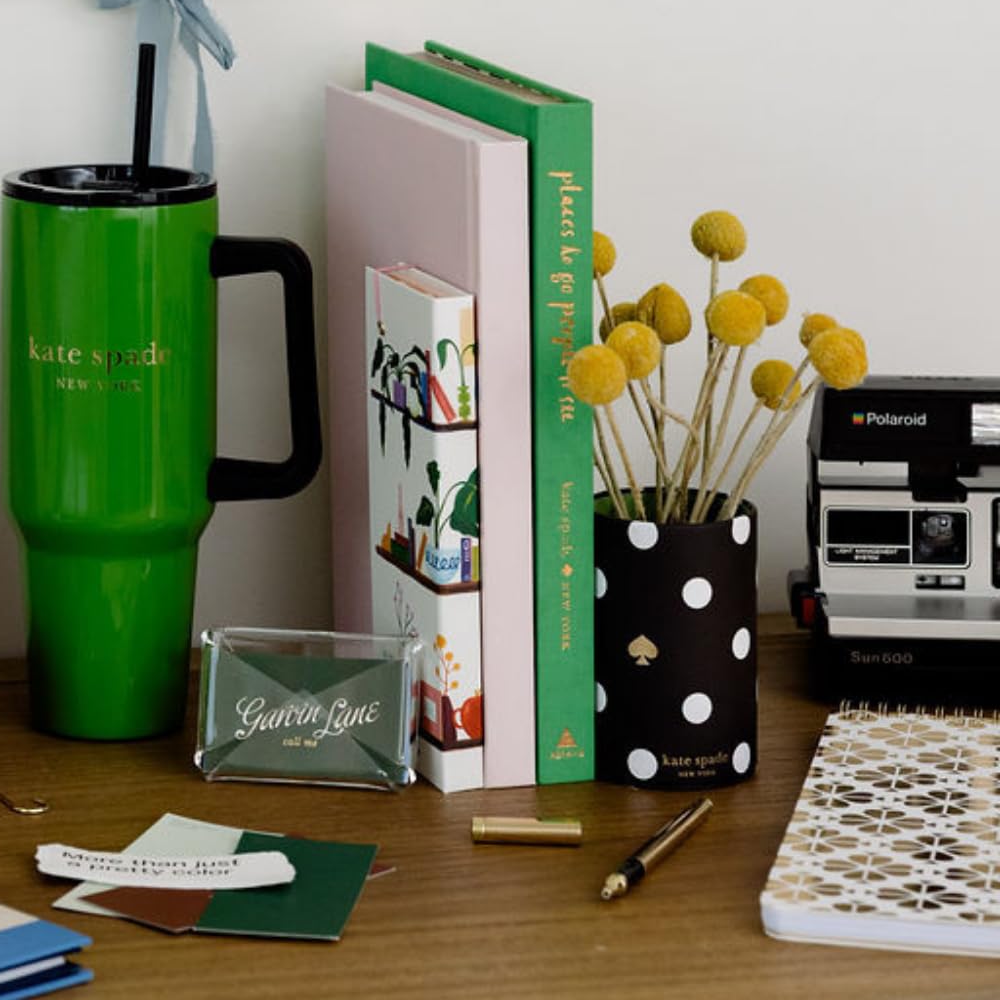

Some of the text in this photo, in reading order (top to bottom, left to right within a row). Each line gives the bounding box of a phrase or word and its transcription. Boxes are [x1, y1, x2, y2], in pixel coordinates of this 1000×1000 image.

[547, 170, 585, 238] places
[559, 244, 583, 265] to
[550, 271, 575, 294] go
[28, 336, 171, 375] kate spade
[56, 377, 89, 391] NEW
[866, 412, 928, 427] Polaroid
[311, 697, 381, 740] Lane
[661, 751, 729, 769] kate spade
[89, 863, 165, 876] pretty
[171, 866, 234, 877] color
[131, 858, 188, 868] than
[194, 858, 241, 869] just
